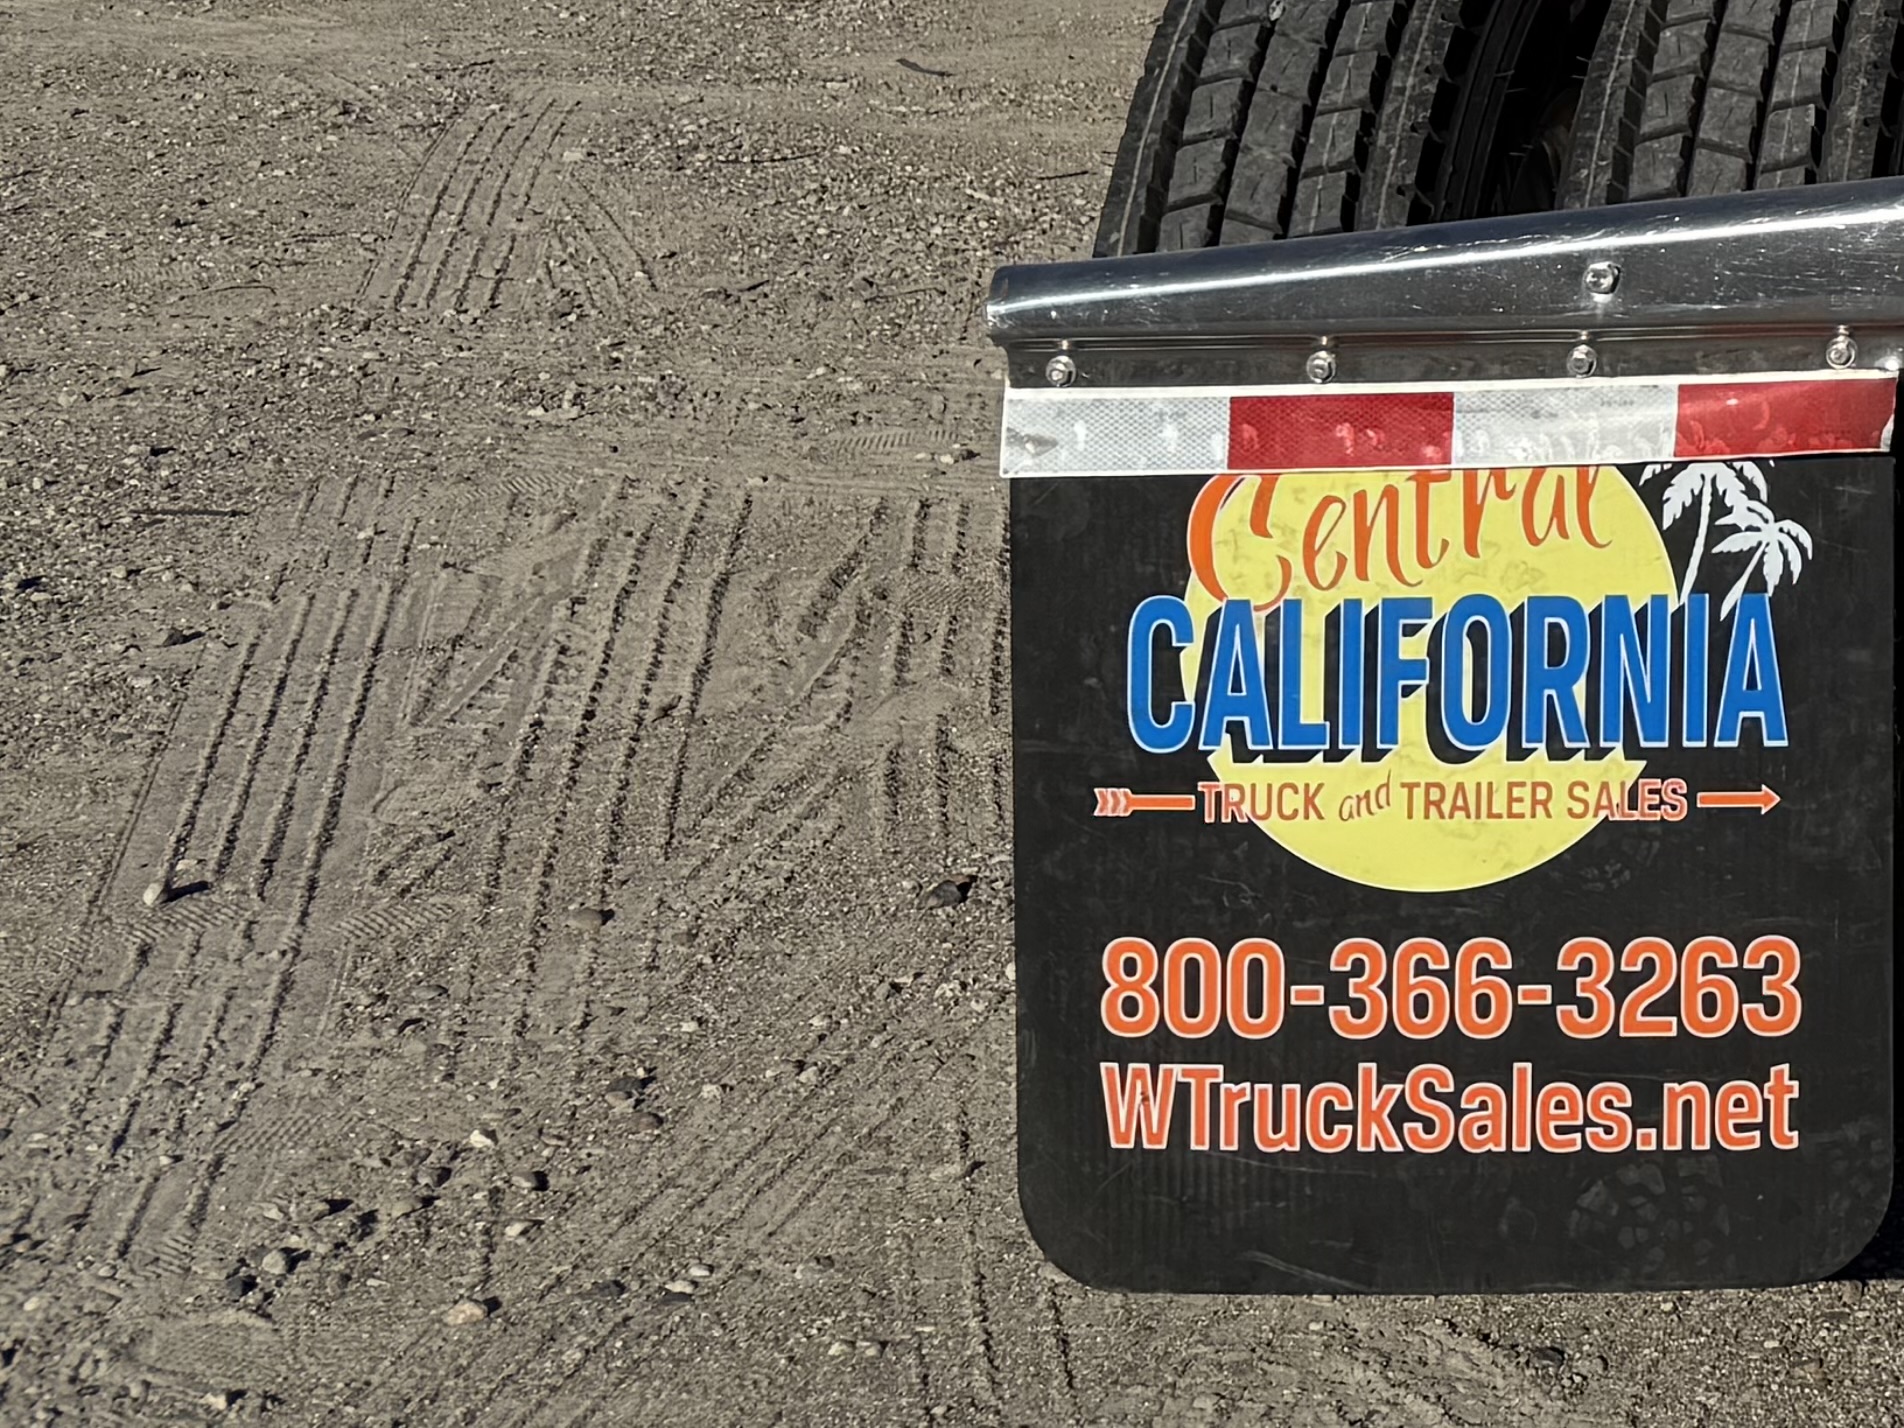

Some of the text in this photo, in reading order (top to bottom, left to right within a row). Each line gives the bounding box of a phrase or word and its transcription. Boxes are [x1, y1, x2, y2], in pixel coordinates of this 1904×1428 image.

[1189, 463, 1613, 611] Central
[1128, 592, 1789, 750] CALIFORNIA
[1198, 769, 1688, 823] TRUCK and TRAILER SALES
[1100, 936, 1802, 1040] 800-366-3263
[1100, 1061, 1800, 1153] WTruckSales.net
